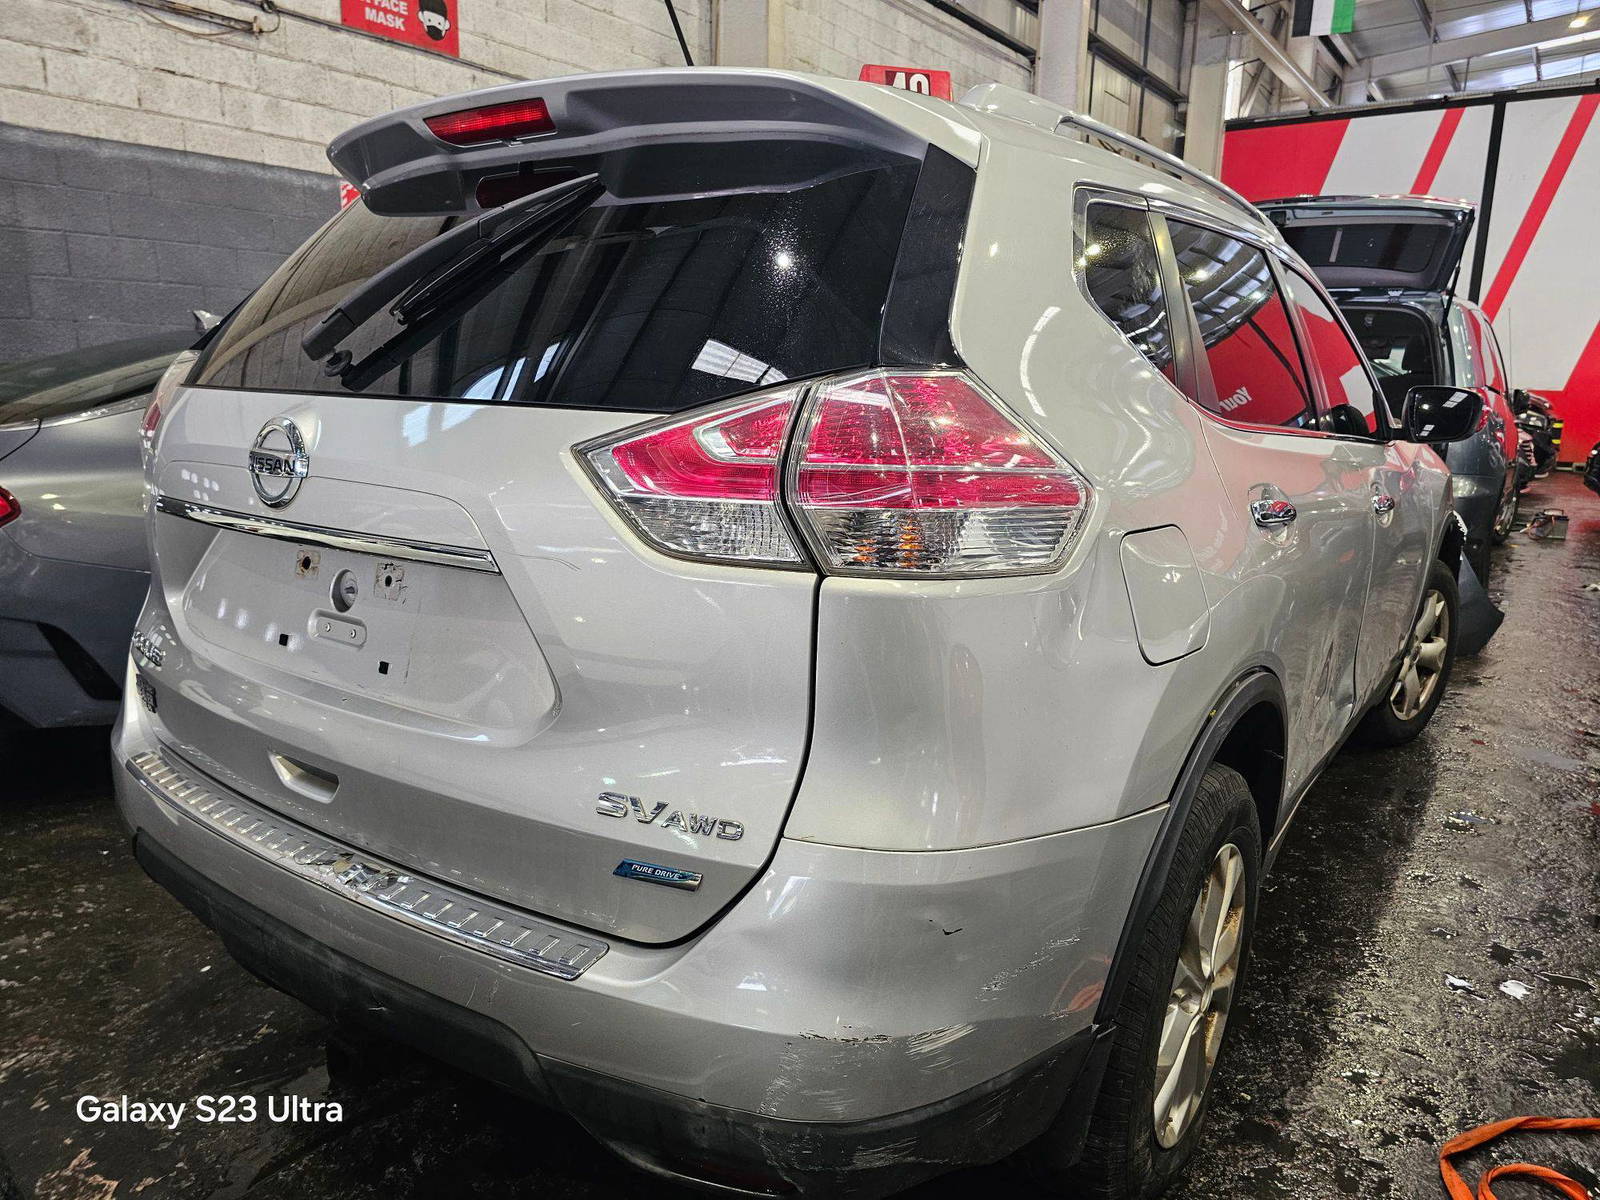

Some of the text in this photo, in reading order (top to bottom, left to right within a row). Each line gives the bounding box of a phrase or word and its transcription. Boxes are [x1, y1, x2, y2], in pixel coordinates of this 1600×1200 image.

[365, 7, 406, 31] MASK
[596, 791, 745, 841] SV AWD
[631, 864, 682, 879] PURE DRIVE
